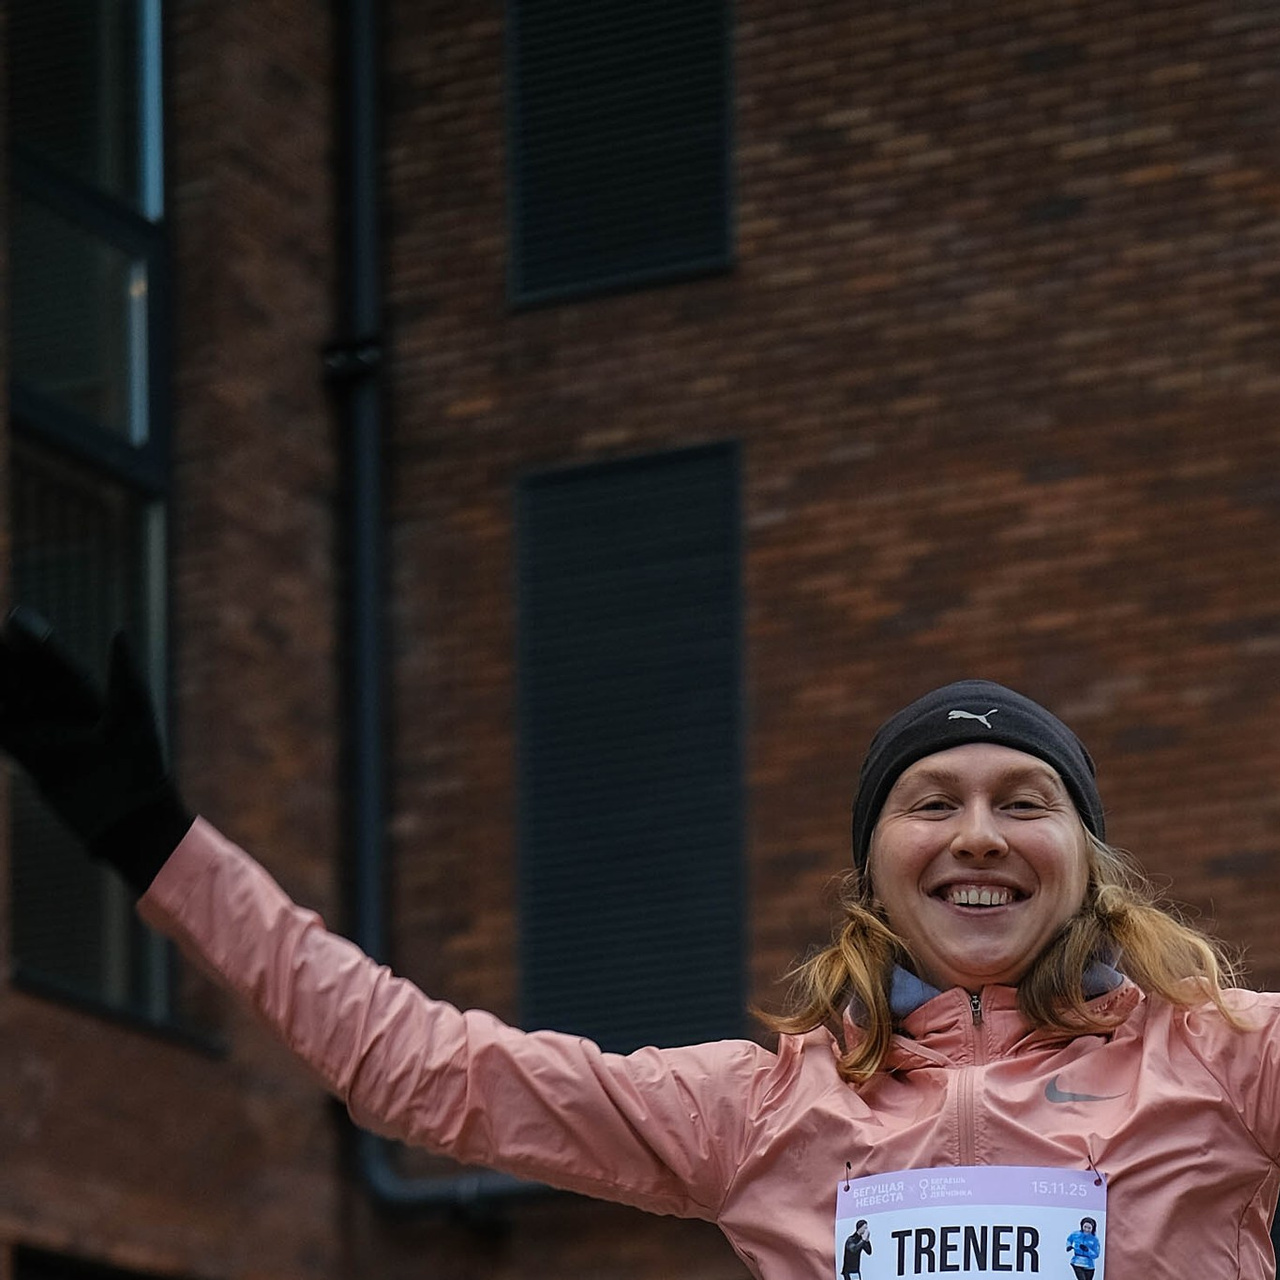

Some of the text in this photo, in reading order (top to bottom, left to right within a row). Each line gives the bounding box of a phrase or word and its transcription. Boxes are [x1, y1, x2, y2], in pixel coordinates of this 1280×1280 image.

[853, 1181, 904, 1198] БЕГУЩАЯ
[1032, 1181, 1087, 1197] 15.11.25
[856, 1193, 904, 1208] НЕВЕСТА
[891, 1225, 1040, 1276] TRENER
